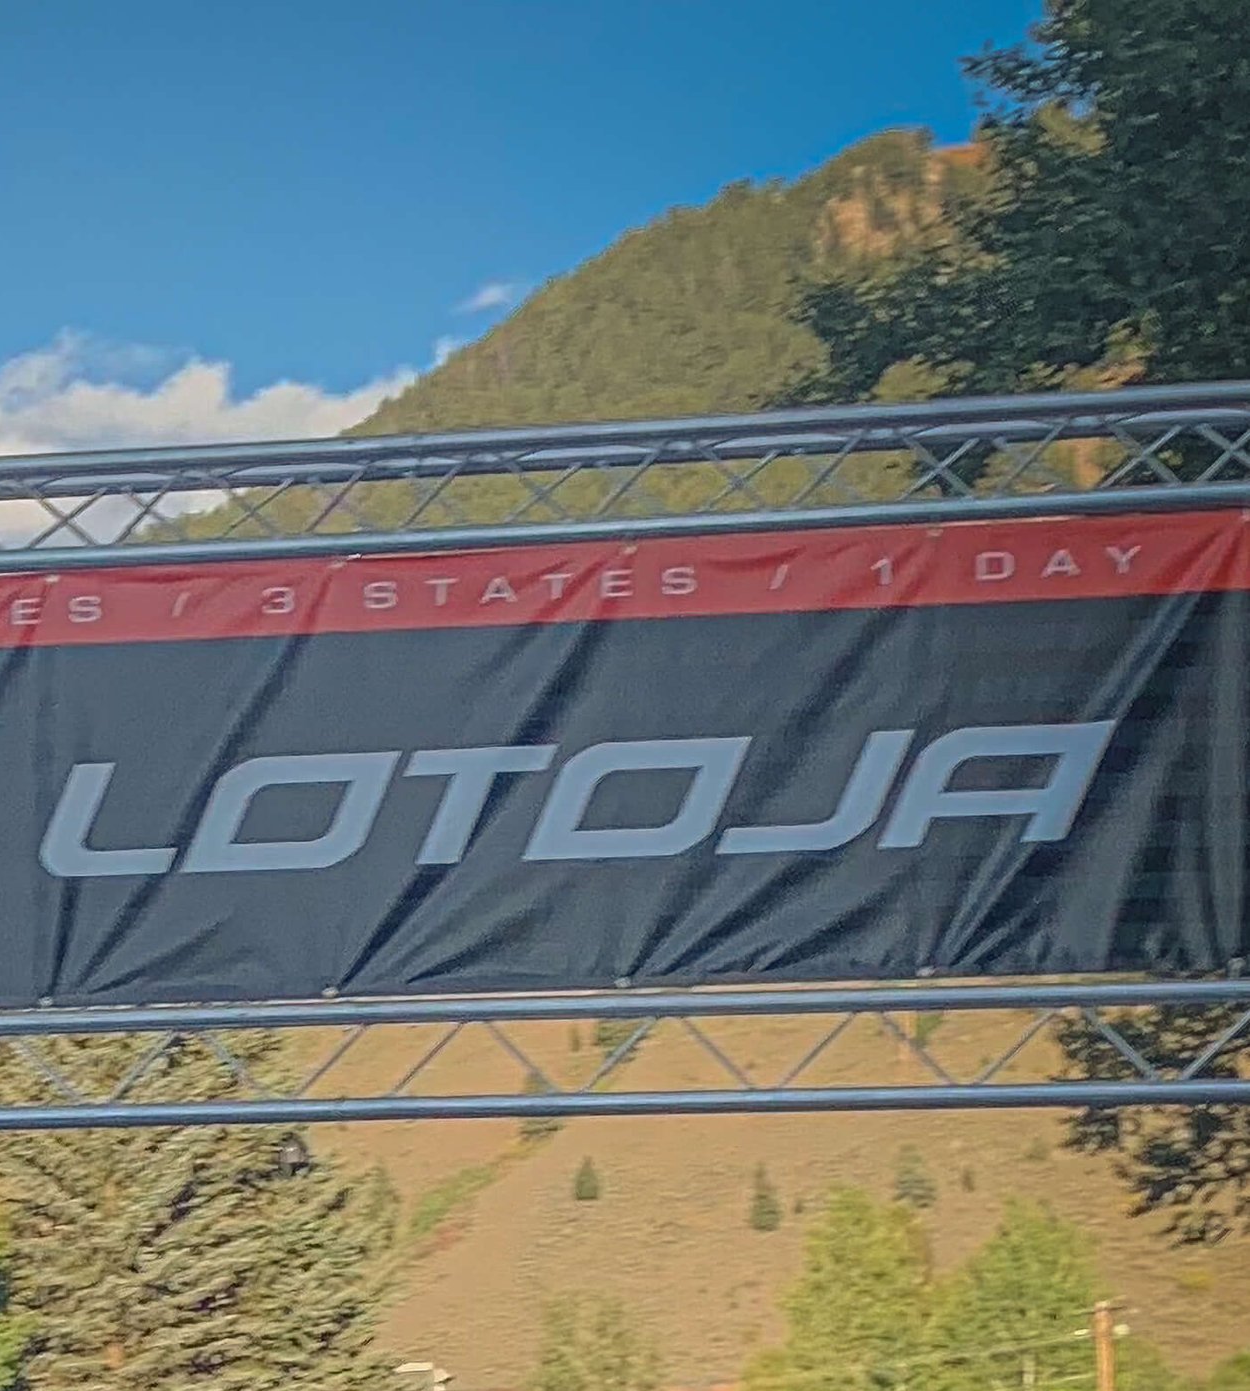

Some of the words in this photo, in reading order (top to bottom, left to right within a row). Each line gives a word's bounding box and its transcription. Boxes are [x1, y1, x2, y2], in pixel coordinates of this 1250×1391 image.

[171, 591, 192, 618] /
[261, 586, 296, 616] 3
[362, 564, 699, 611] STATES
[768, 562, 789, 592] /
[870, 556, 894, 587] 1
[974, 543, 1142, 583] DAY
[37, 718, 1117, 878] LOTOJA
